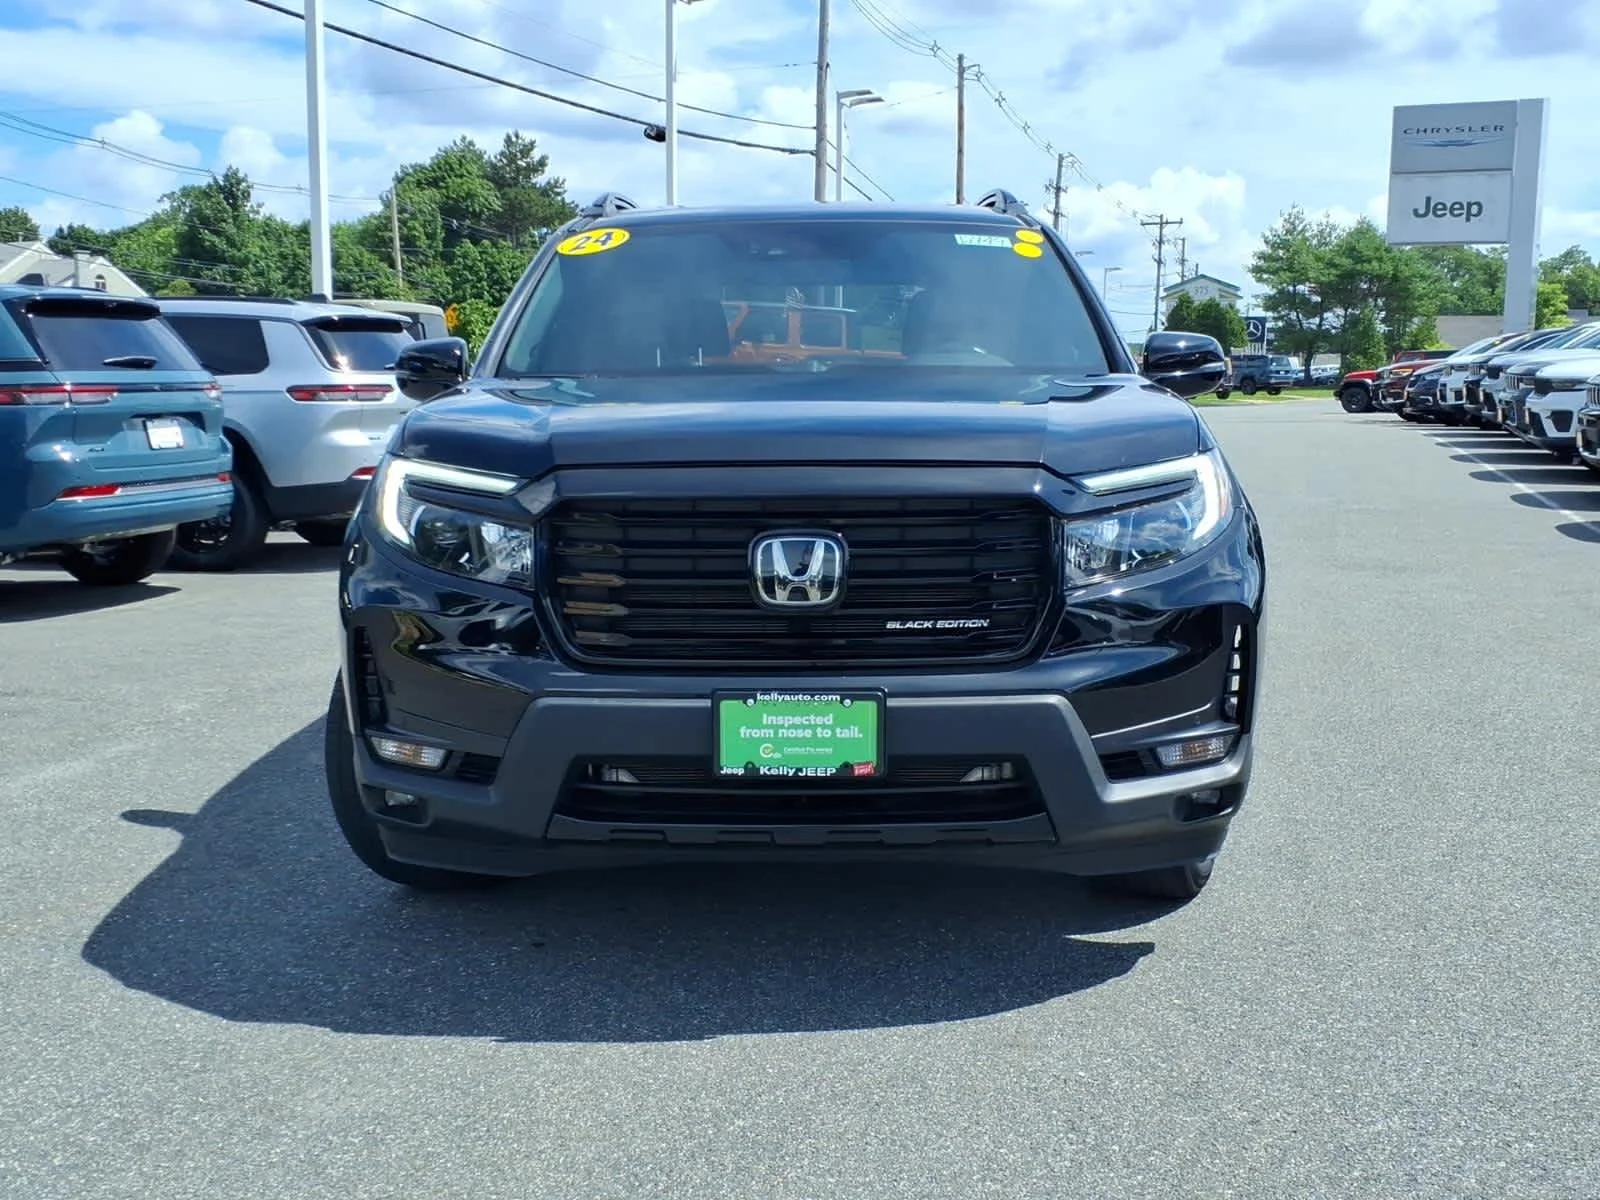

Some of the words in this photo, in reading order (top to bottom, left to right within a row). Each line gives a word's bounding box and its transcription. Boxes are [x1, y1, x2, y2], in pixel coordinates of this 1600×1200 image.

[1403, 124, 1505, 135] CHRYSLER
[1412, 196, 1483, 223] Jeep
[567, 231, 614, 252] 24
[886, 620, 935, 629] BLACK
[936, 618, 990, 628] EDITION
[756, 692, 840, 702] kellyauto.com
[762, 713, 834, 727] Inspected
[739, 726, 774, 738] from
[778, 728, 812, 738] nose
[816, 727, 832, 738] to
[835, 726, 864, 738] tail.
[720, 767, 745, 775] Jeep
[760, 766, 795, 777] Kelly
[798, 767, 837, 777] JEEP
